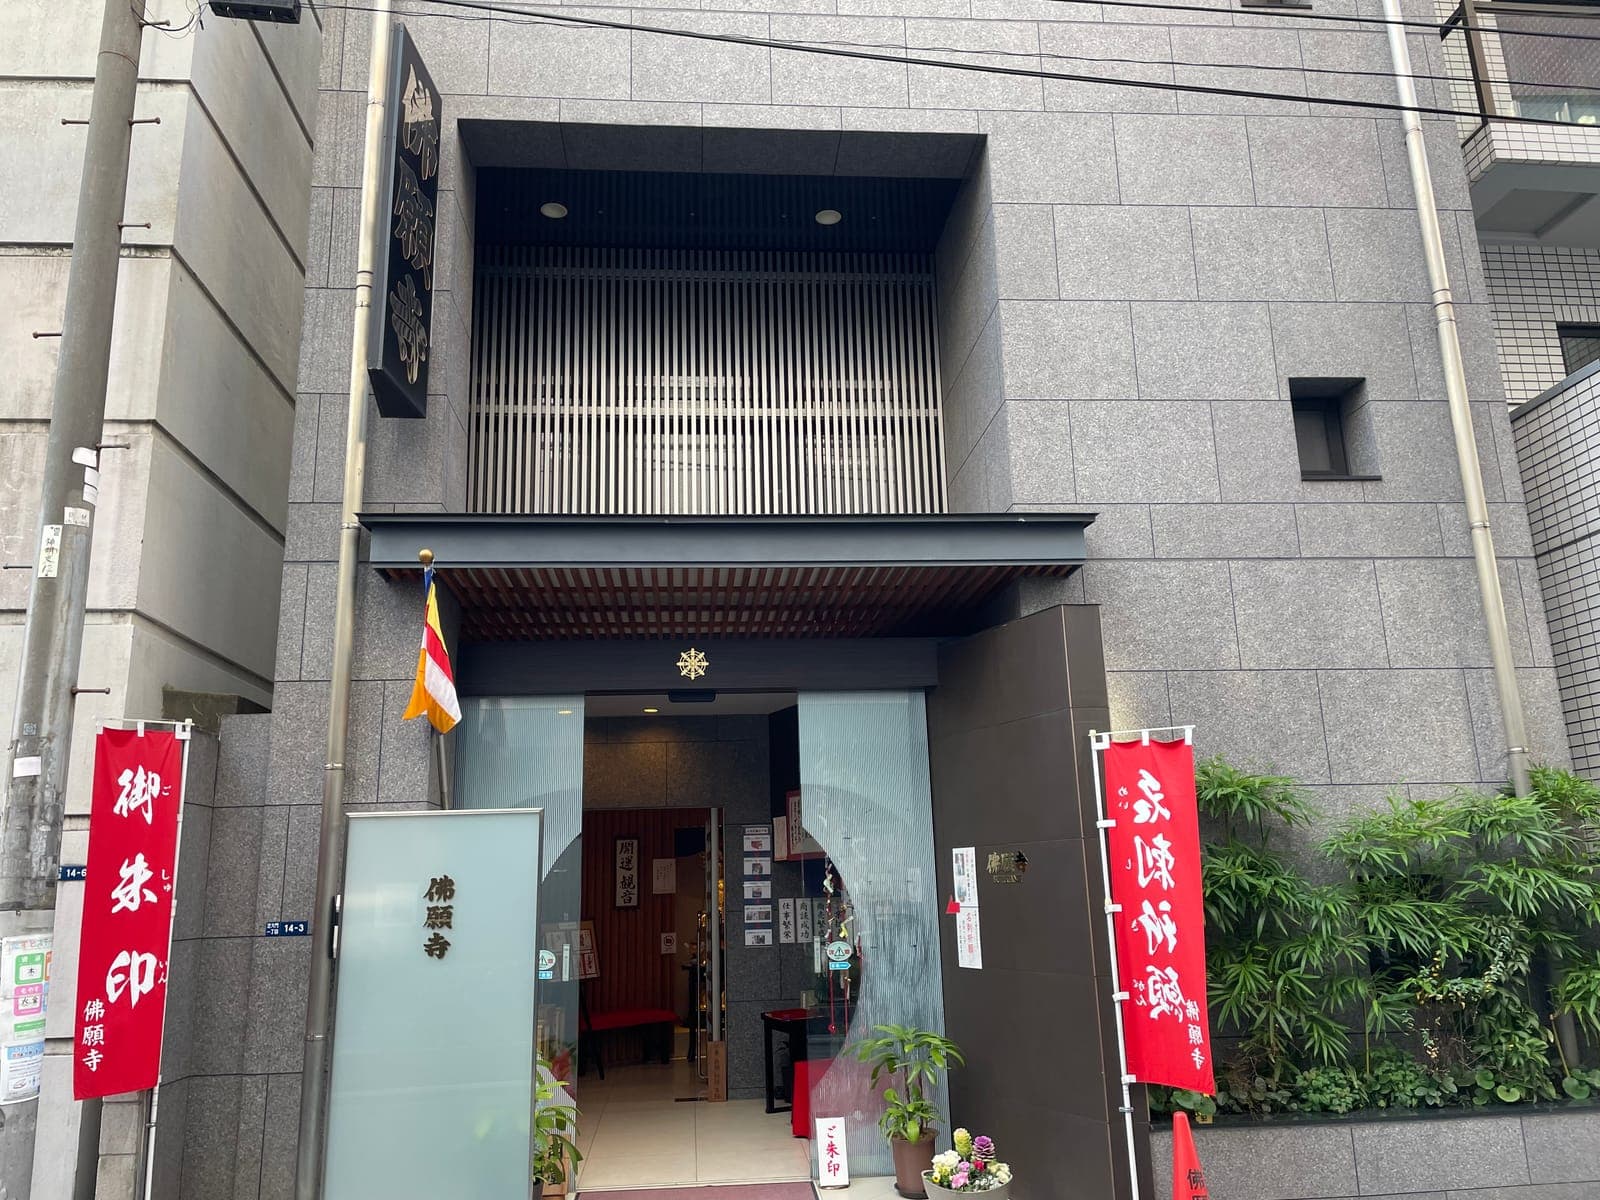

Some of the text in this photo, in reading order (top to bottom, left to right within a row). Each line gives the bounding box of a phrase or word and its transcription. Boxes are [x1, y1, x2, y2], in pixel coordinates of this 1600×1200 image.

[162, 785, 172, 796] ご
[66, 868, 87, 878] 14-6
[106, 765, 161, 1010] 御朱印
[162, 868, 172, 893] しゅ
[284, 923, 304, 933] 14-3
[423, 874, 456, 960] 佛願寺
[82, 998, 106, 1072] 佛願寺
[826, 1125, 841, 1177] ご朱印
